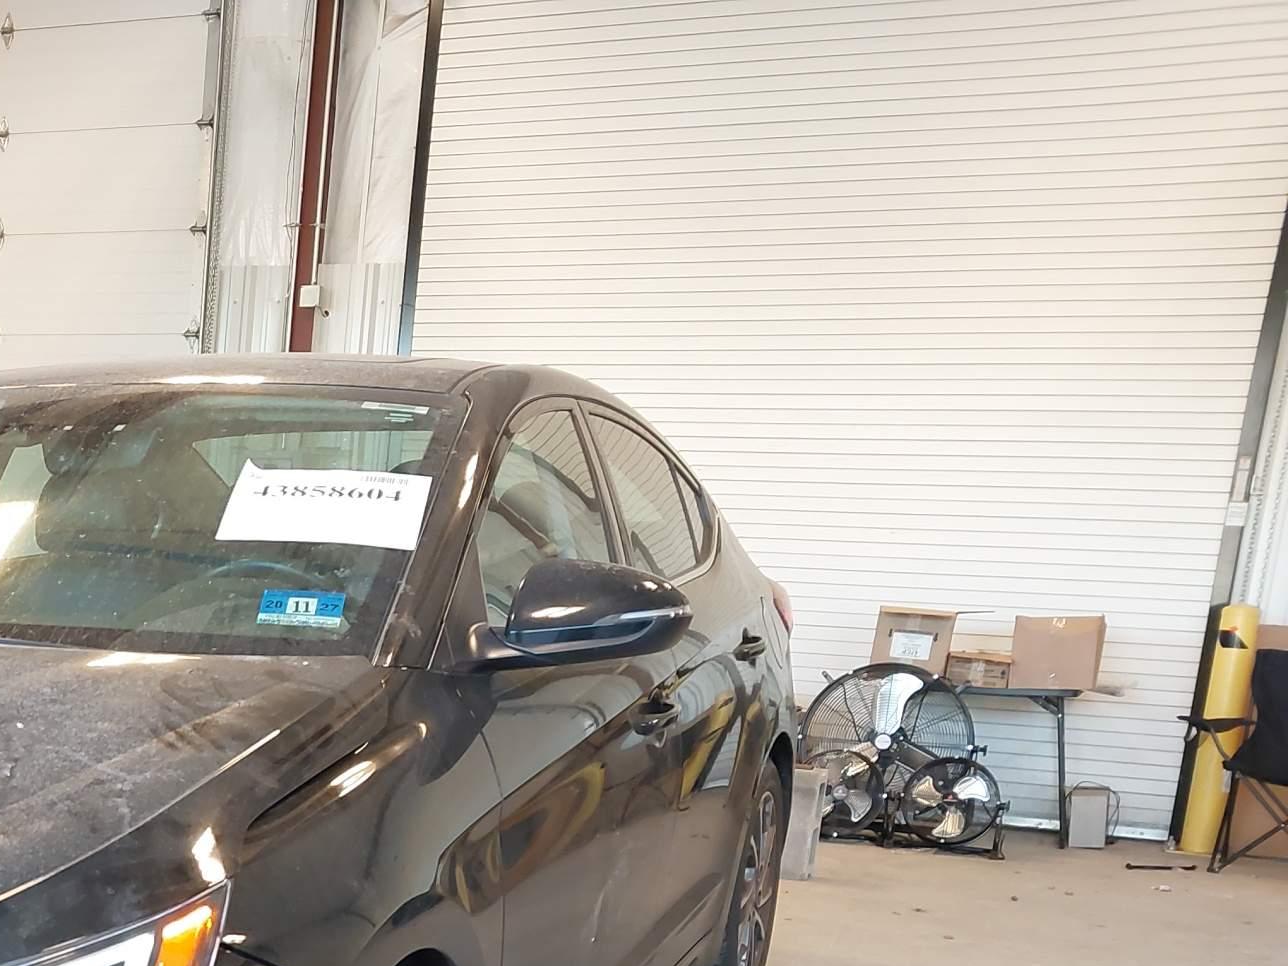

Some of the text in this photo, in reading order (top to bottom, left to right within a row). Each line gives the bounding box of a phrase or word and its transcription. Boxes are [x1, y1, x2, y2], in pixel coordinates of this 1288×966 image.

[253, 485, 402, 502] 43858604
[265, 600, 339, 613] 20 11 27
